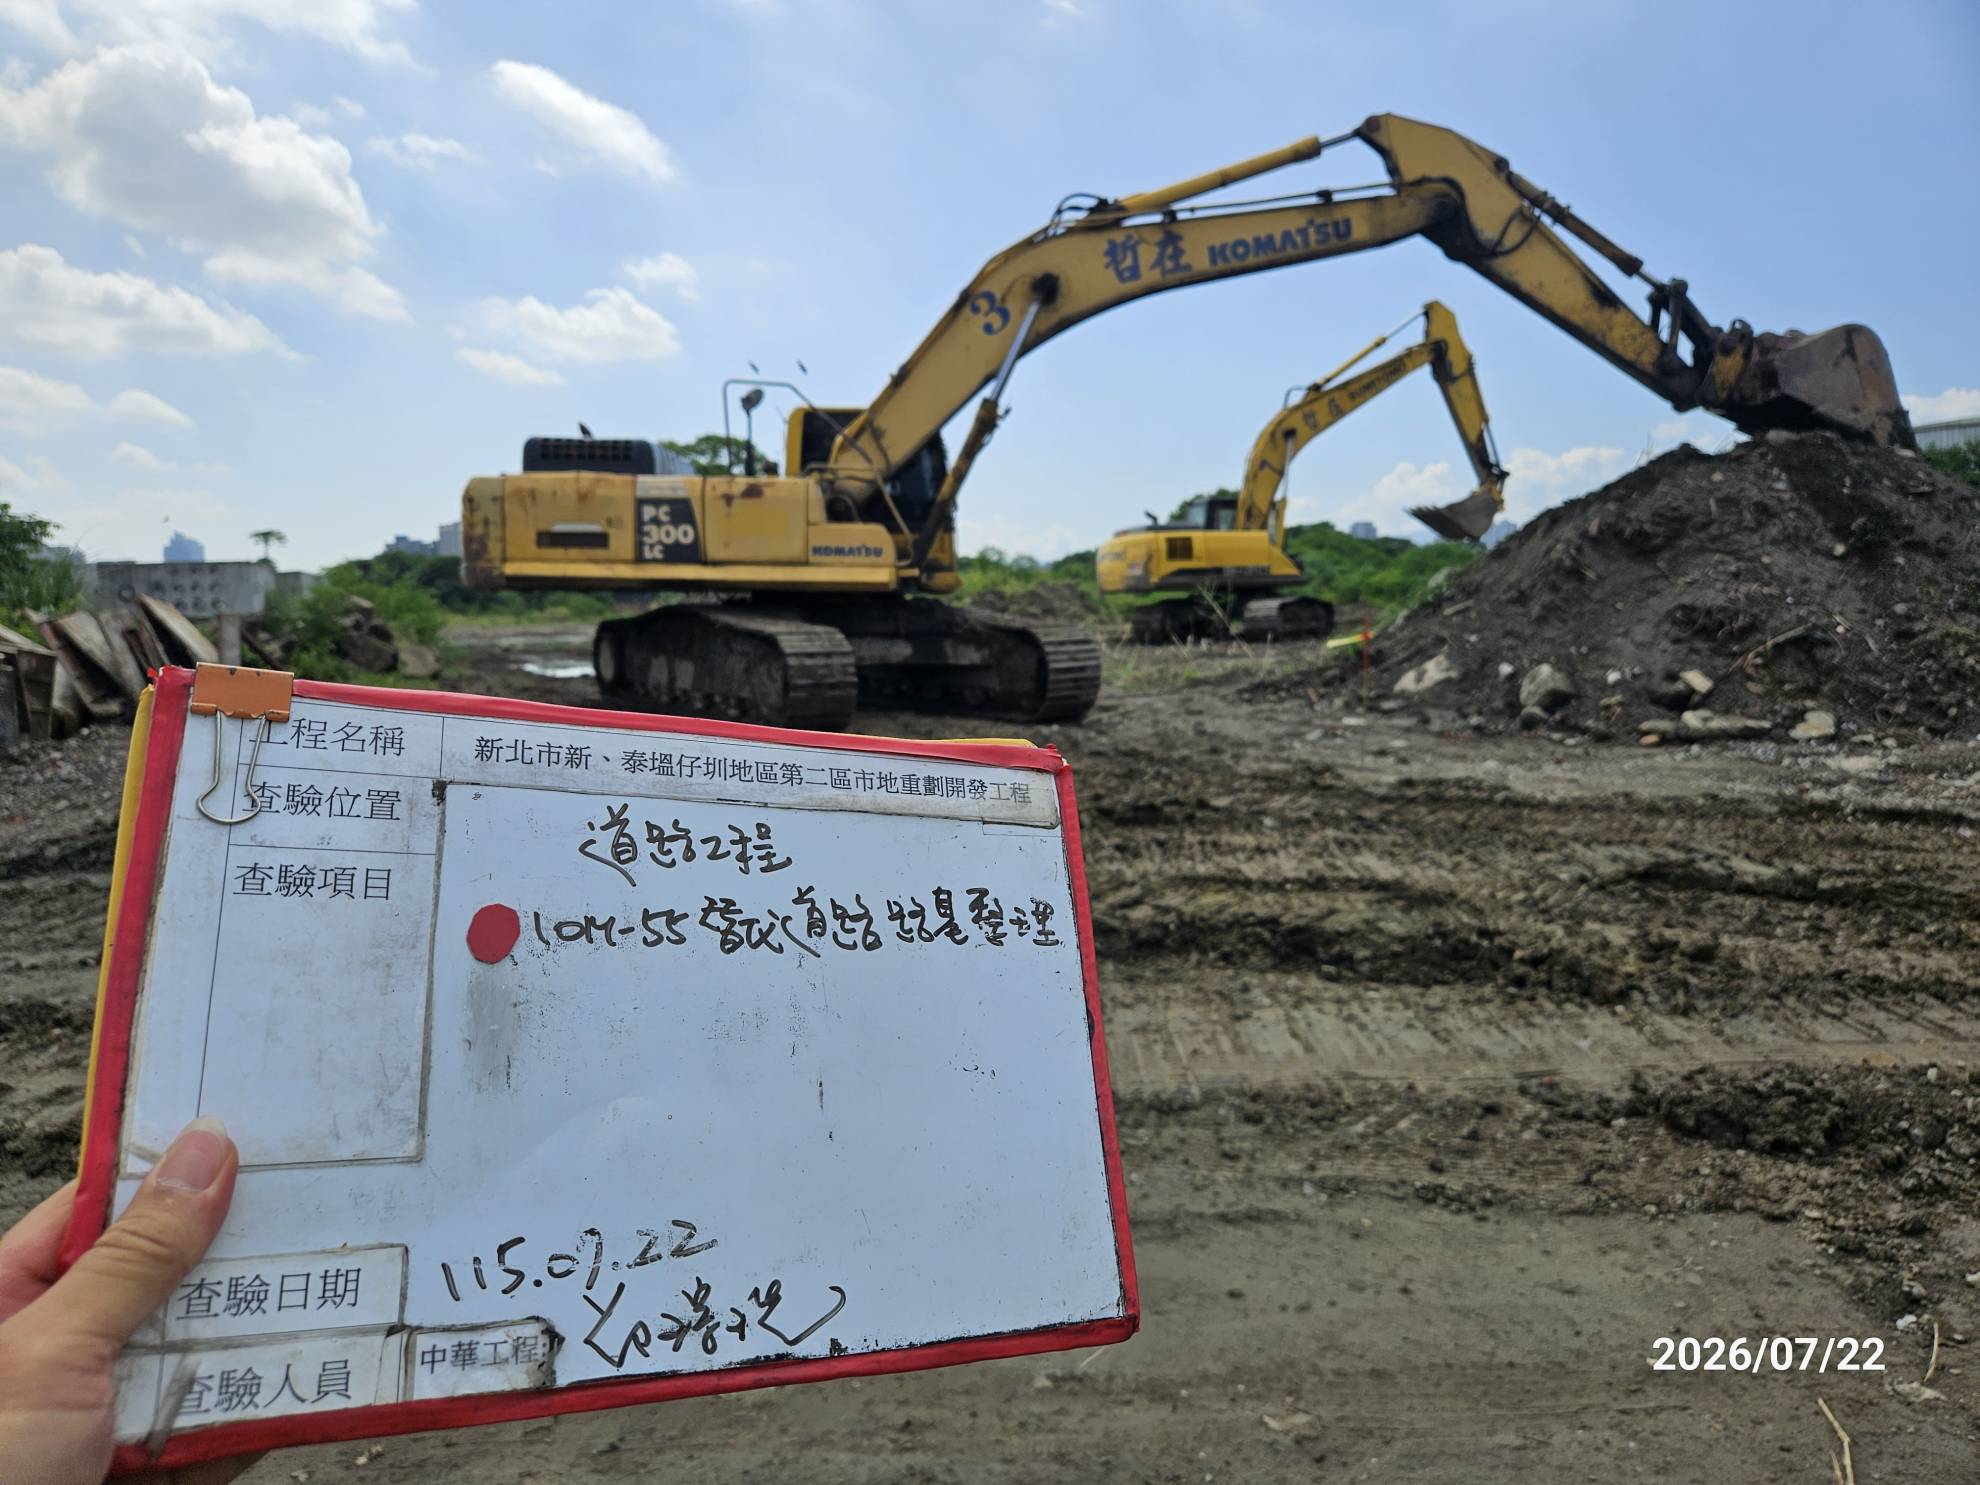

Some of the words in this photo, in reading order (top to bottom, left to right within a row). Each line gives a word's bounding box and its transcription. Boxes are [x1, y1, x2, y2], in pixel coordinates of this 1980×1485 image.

[1208, 218, 1353, 268] KOMATSU
[969, 289, 1011, 336] 3
[642, 504, 671, 522] PC
[642, 523, 695, 545] 300
[474, 735, 1033, 804] 新北市新、泰塭仔圳地區第二區市地重劃開發工程
[242, 781, 402, 821] 查驗位置
[233, 862, 392, 901] 查驗項目
[175, 1266, 363, 1320] 查驗日期
[178, 1358, 353, 1416] 查驗人員
